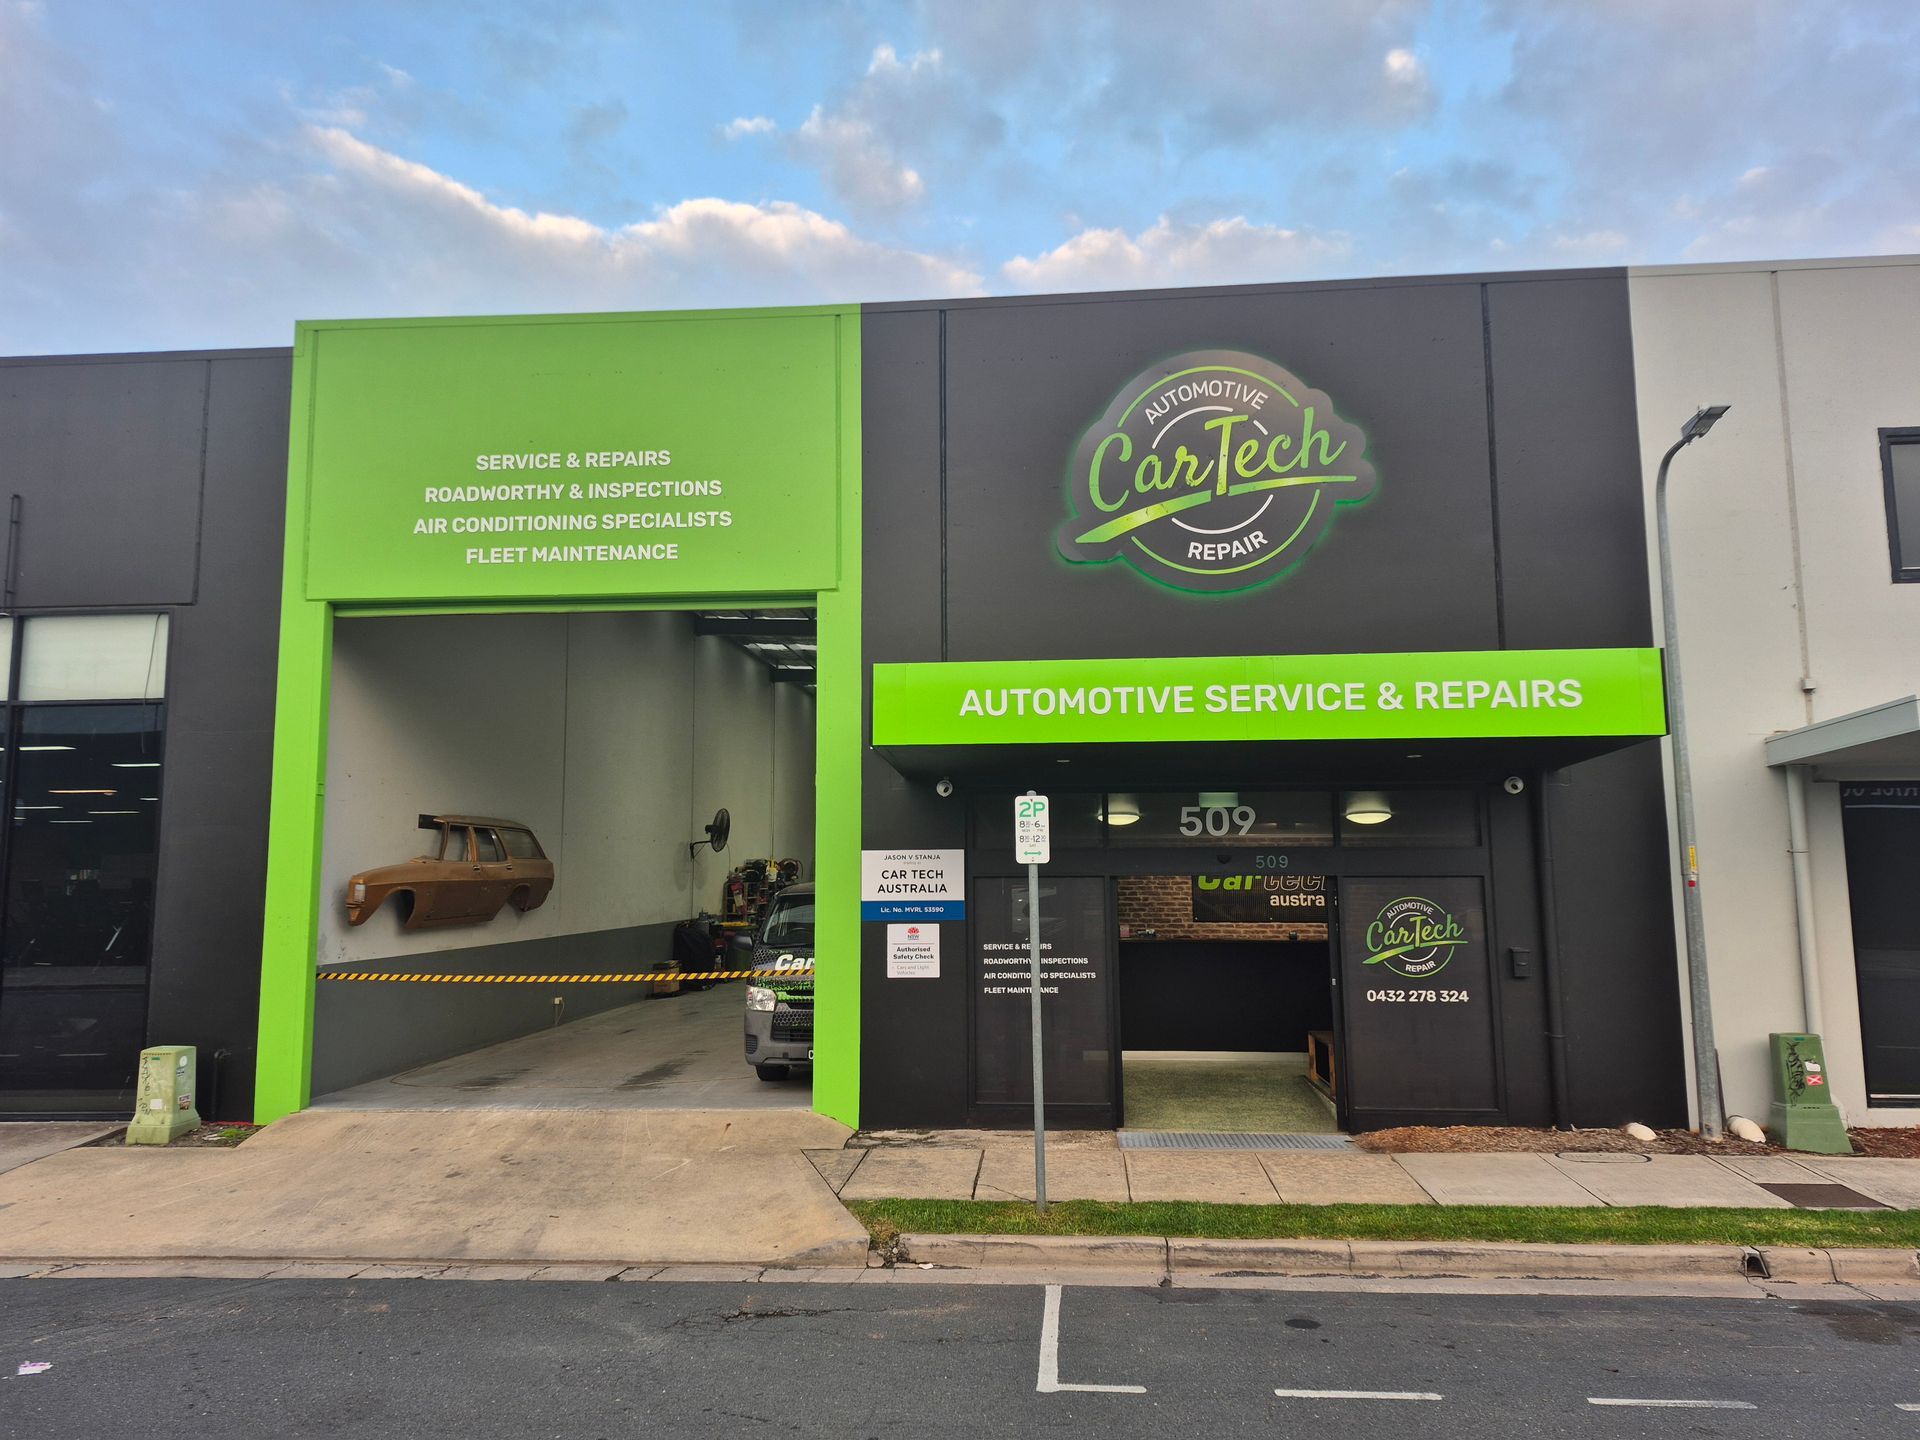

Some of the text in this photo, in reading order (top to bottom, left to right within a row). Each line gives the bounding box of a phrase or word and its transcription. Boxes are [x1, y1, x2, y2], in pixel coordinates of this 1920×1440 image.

[1144, 380, 1269, 425] AUTOMOTIVE
[476, 450, 672, 471] SERVICE & REPAIRS
[425, 480, 722, 504] ROADWORTHY & INSPECTIONS
[413, 511, 733, 534] AIR CONDITIONING SPECIALISTS
[466, 544, 678, 564] FLEET MAINTENANCE
[1188, 530, 1269, 560] REPAIR
[958, 678, 1584, 717] AUTOMOTIVE SERVICE & REPAIRS
[1019, 802, 1046, 818] 2P
[1180, 806, 1256, 836] 509
[1256, 856, 1288, 868] 509
[882, 870, 944, 880] CAR TECH
[878, 884, 948, 894] AUSTRALIA
[1386, 902, 1434, 919] AUTOMOTIVE
[1406, 960, 1436, 972] REPAIR
[1366, 990, 1469, 1002] 0432 278 324
